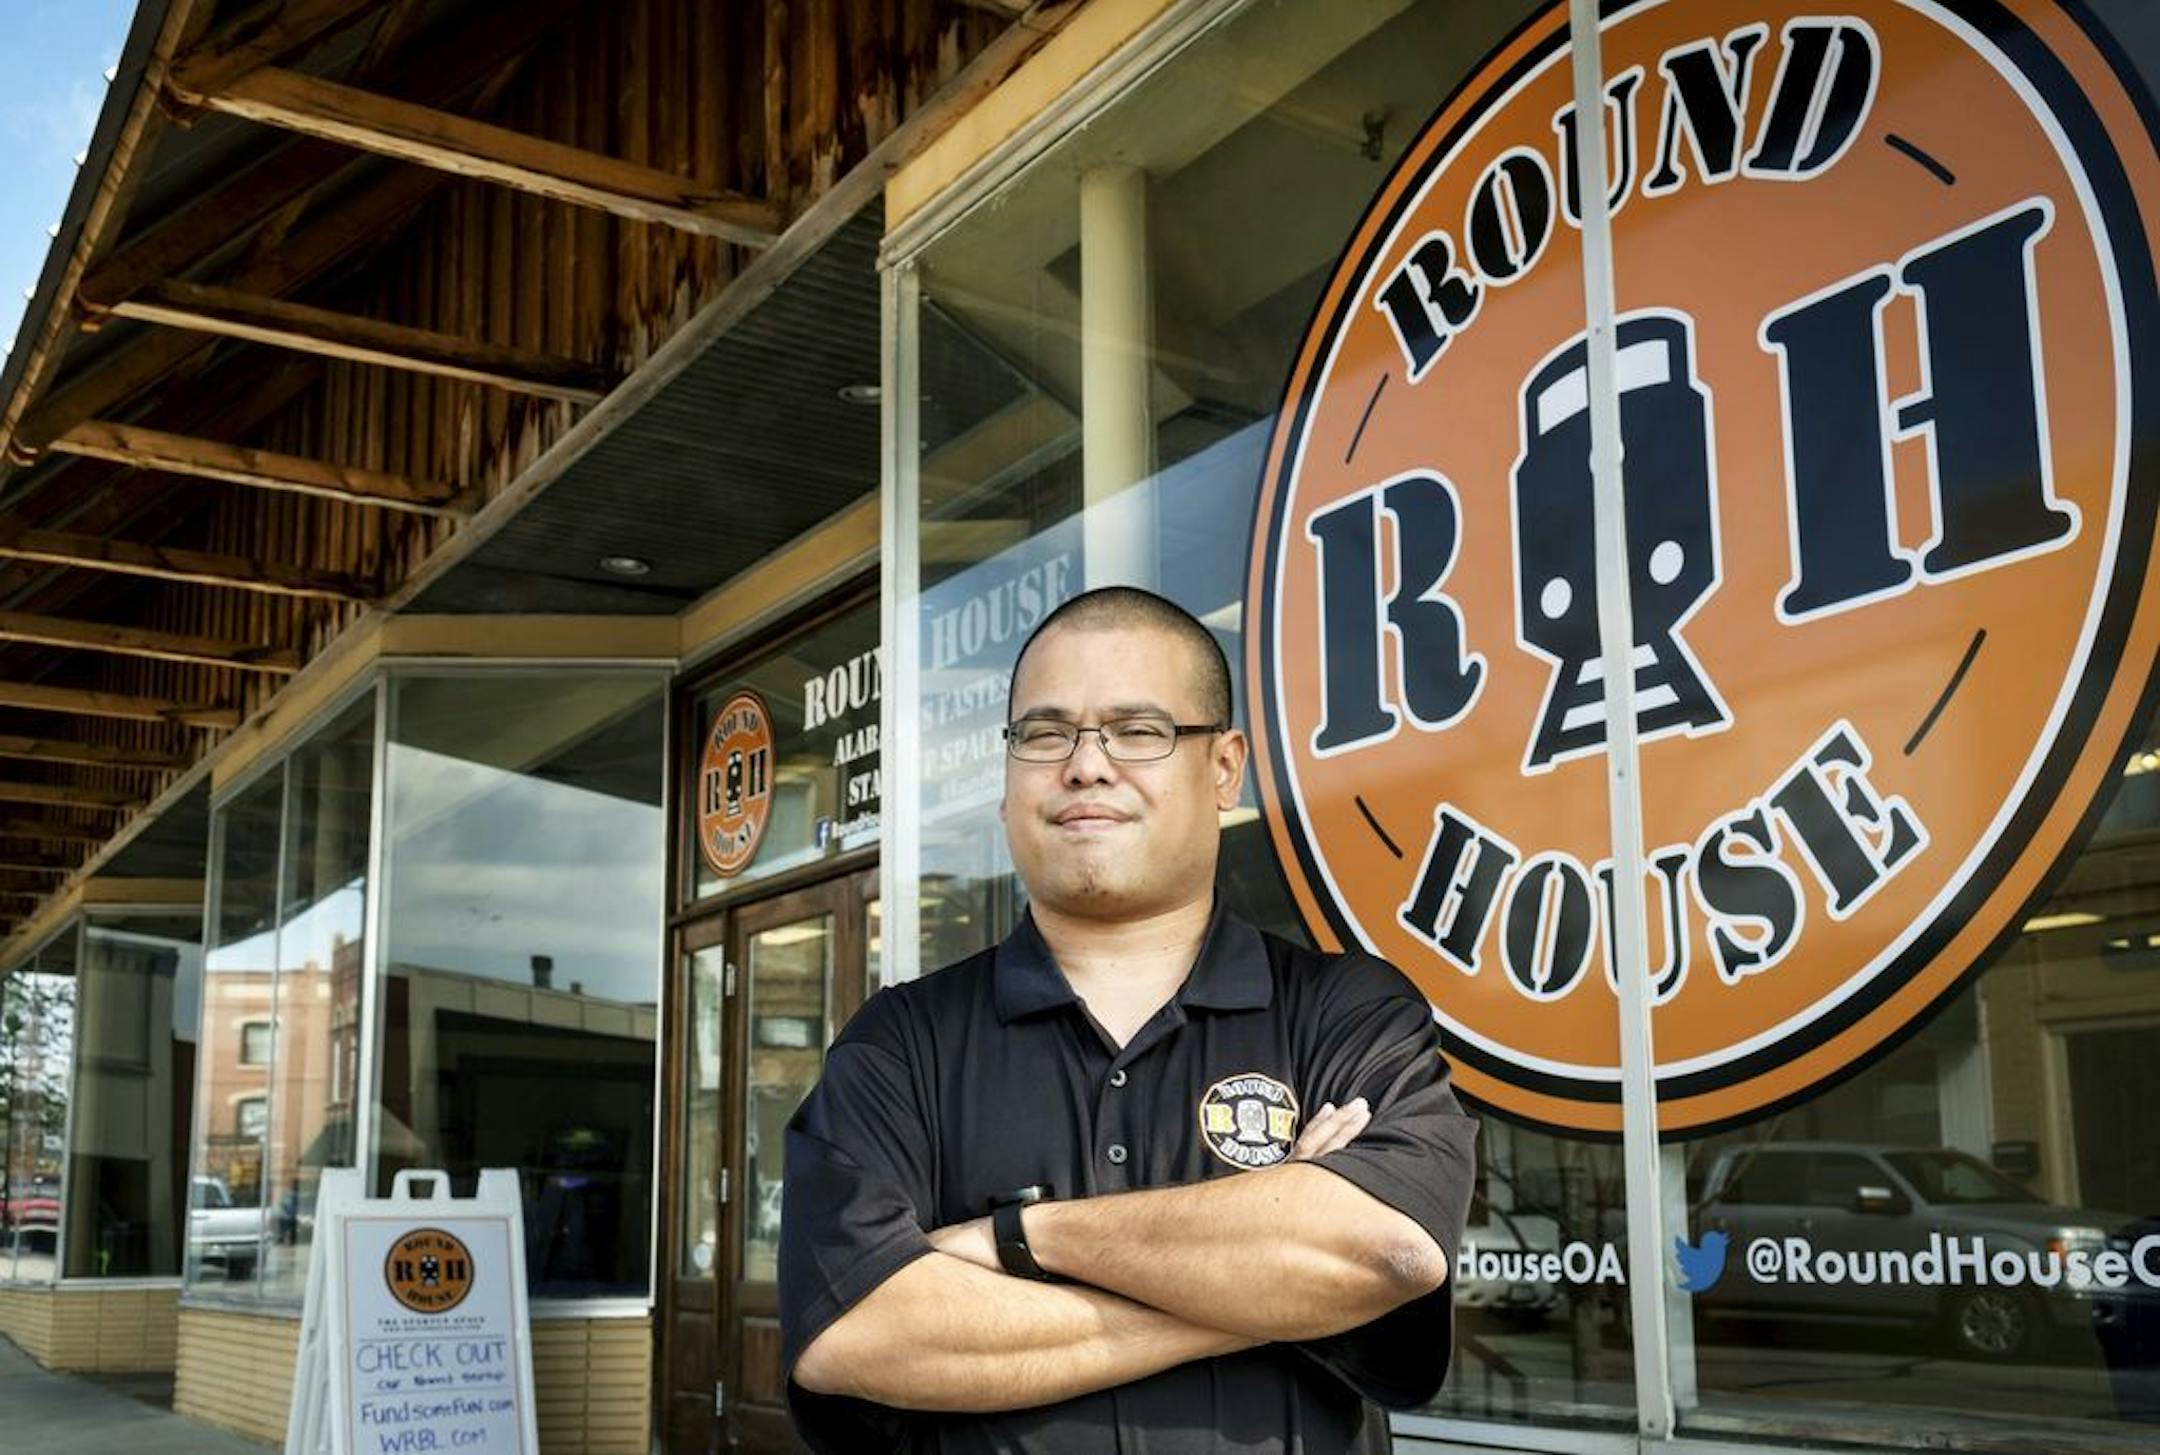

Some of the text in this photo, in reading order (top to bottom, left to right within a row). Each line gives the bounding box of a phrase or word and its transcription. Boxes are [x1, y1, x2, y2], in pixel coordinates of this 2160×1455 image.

[1375, 16, 1880, 383] ROUND
[1306, 196, 2082, 758] R H
[931, 552, 1070, 671] HOUSE
[833, 724, 881, 767] ALAB
[1398, 719, 1930, 1004] HOUSE
[356, 1341, 507, 1374] CHECK OUT
